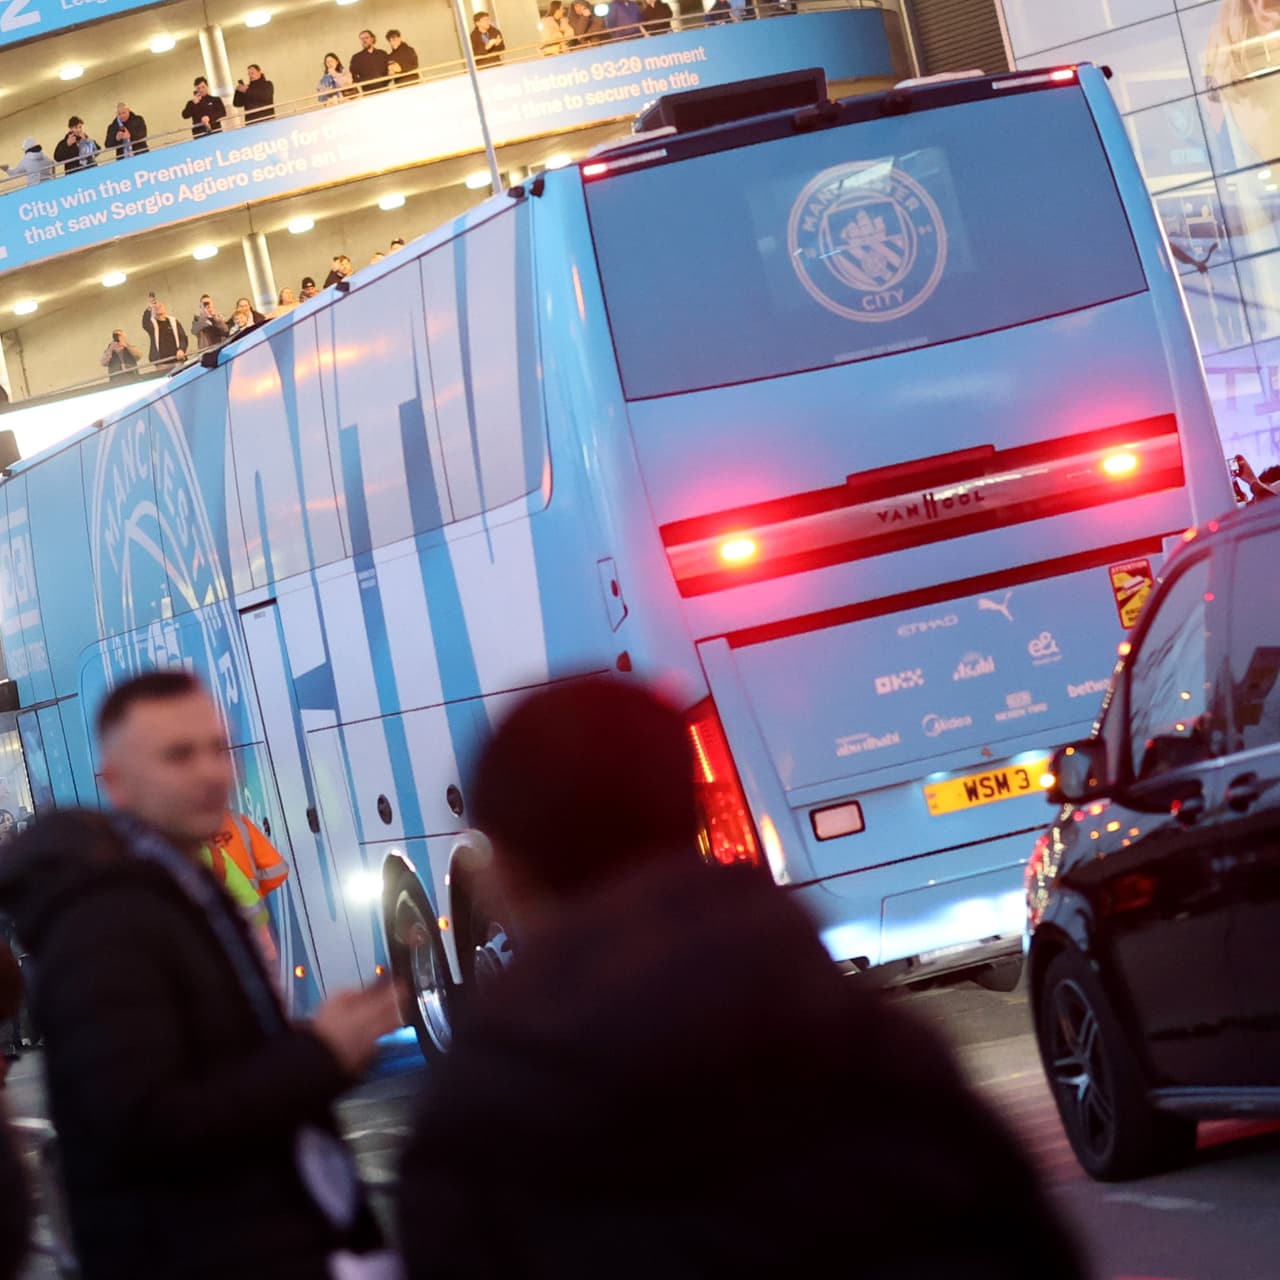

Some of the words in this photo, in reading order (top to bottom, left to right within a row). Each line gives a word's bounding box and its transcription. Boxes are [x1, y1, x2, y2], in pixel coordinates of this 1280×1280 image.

[523, 68, 589, 95] historic
[591, 56, 643, 81] 93:20
[644, 46, 707, 71] moment
[566, 94, 584, 111] to
[585, 80, 641, 105] secure
[641, 75, 668, 94] the
[669, 69, 700, 90] title
[18, 197, 59, 222] City
[60, 188, 96, 211] win
[98, 175, 132, 199] the
[133, 152, 213, 189] Premier
[216, 137, 289, 168] League
[290, 124, 320, 147] for
[24, 220, 65, 245] that
[67, 210, 108, 233] saw
[110, 185, 174, 220] Sergio
[178, 166, 249, 203] Agüero
[252, 155, 307, 183] score
[861, 287, 905, 312] CITY
[877, 503, 920, 523] VAN
[963, 772, 1011, 803] WSM
[1014, 768, 1031, 791] 3
